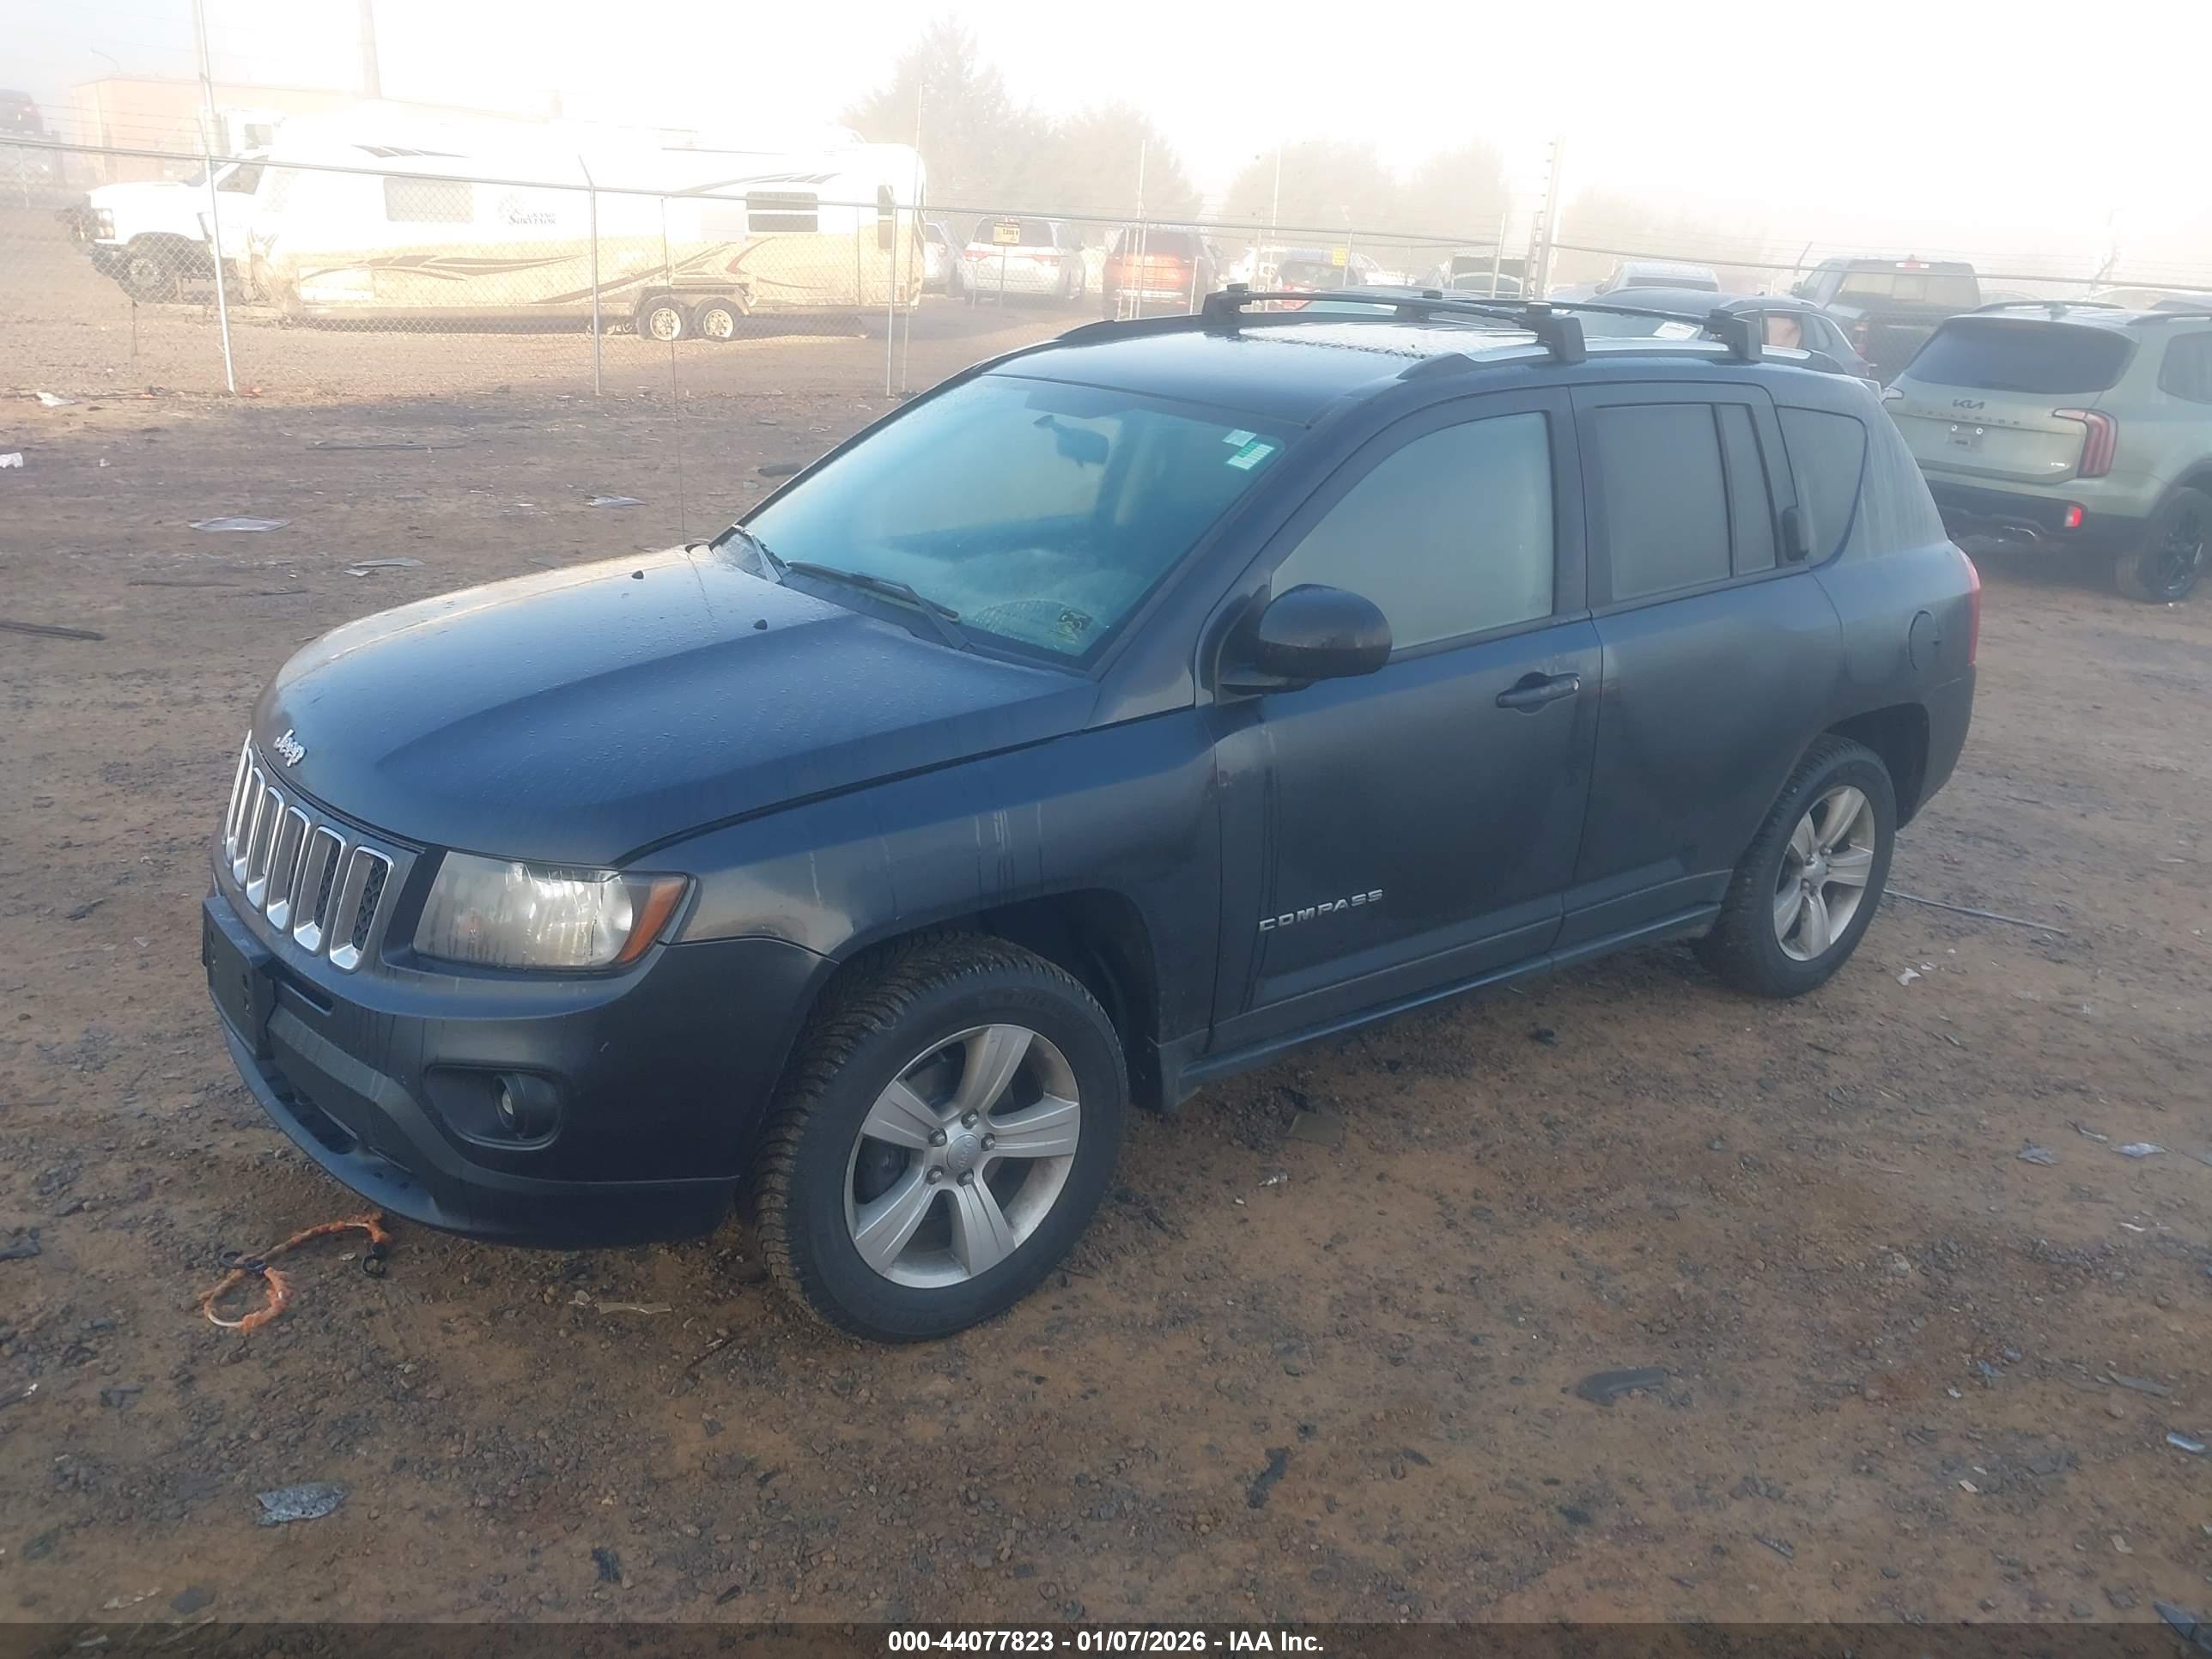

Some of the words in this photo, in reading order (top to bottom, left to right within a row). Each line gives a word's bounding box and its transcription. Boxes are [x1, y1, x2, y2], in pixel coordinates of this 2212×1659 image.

[1952, 398, 1985, 410] KIA
[273, 728, 306, 767] Jeep
[1258, 888, 1384, 933] COMPASS
